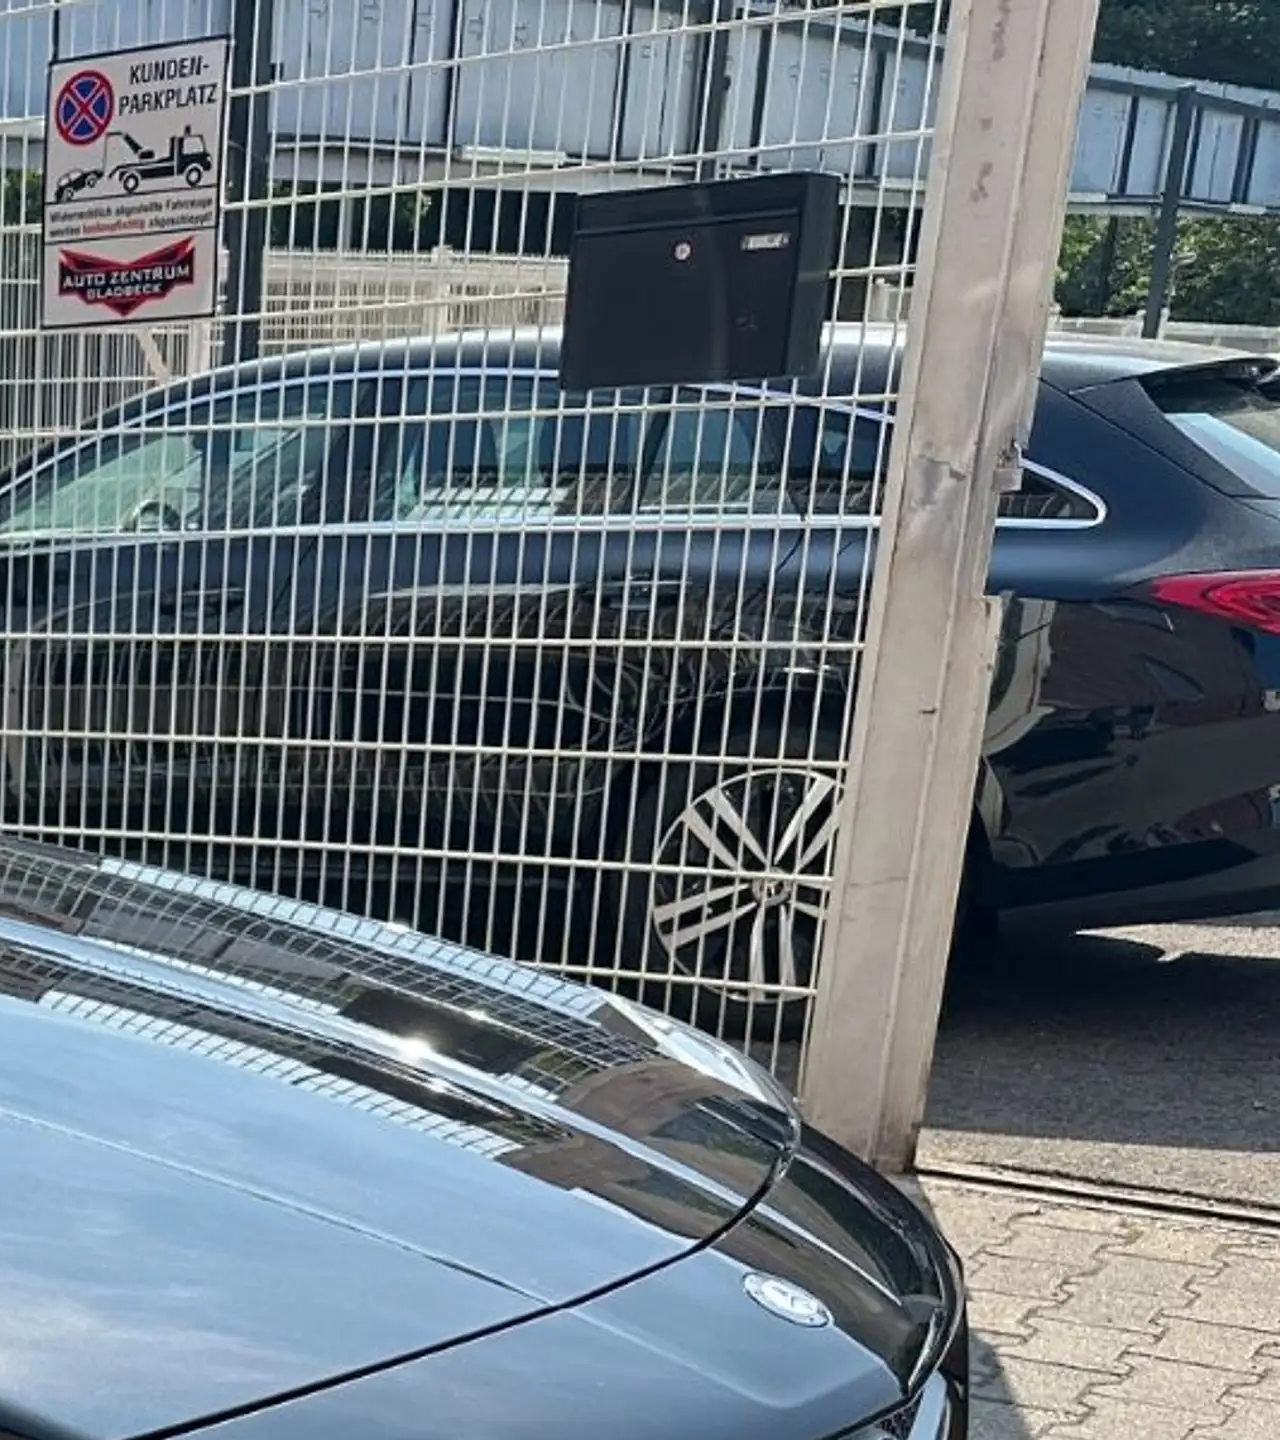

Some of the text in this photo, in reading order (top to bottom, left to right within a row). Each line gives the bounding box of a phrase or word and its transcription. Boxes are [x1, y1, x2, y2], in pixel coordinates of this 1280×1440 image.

[130, 55, 209, 85] KUNDEN-
[118, 83, 218, 116] PARKPLATZ
[63, 264, 190, 289] AUTO ZENTRUM
